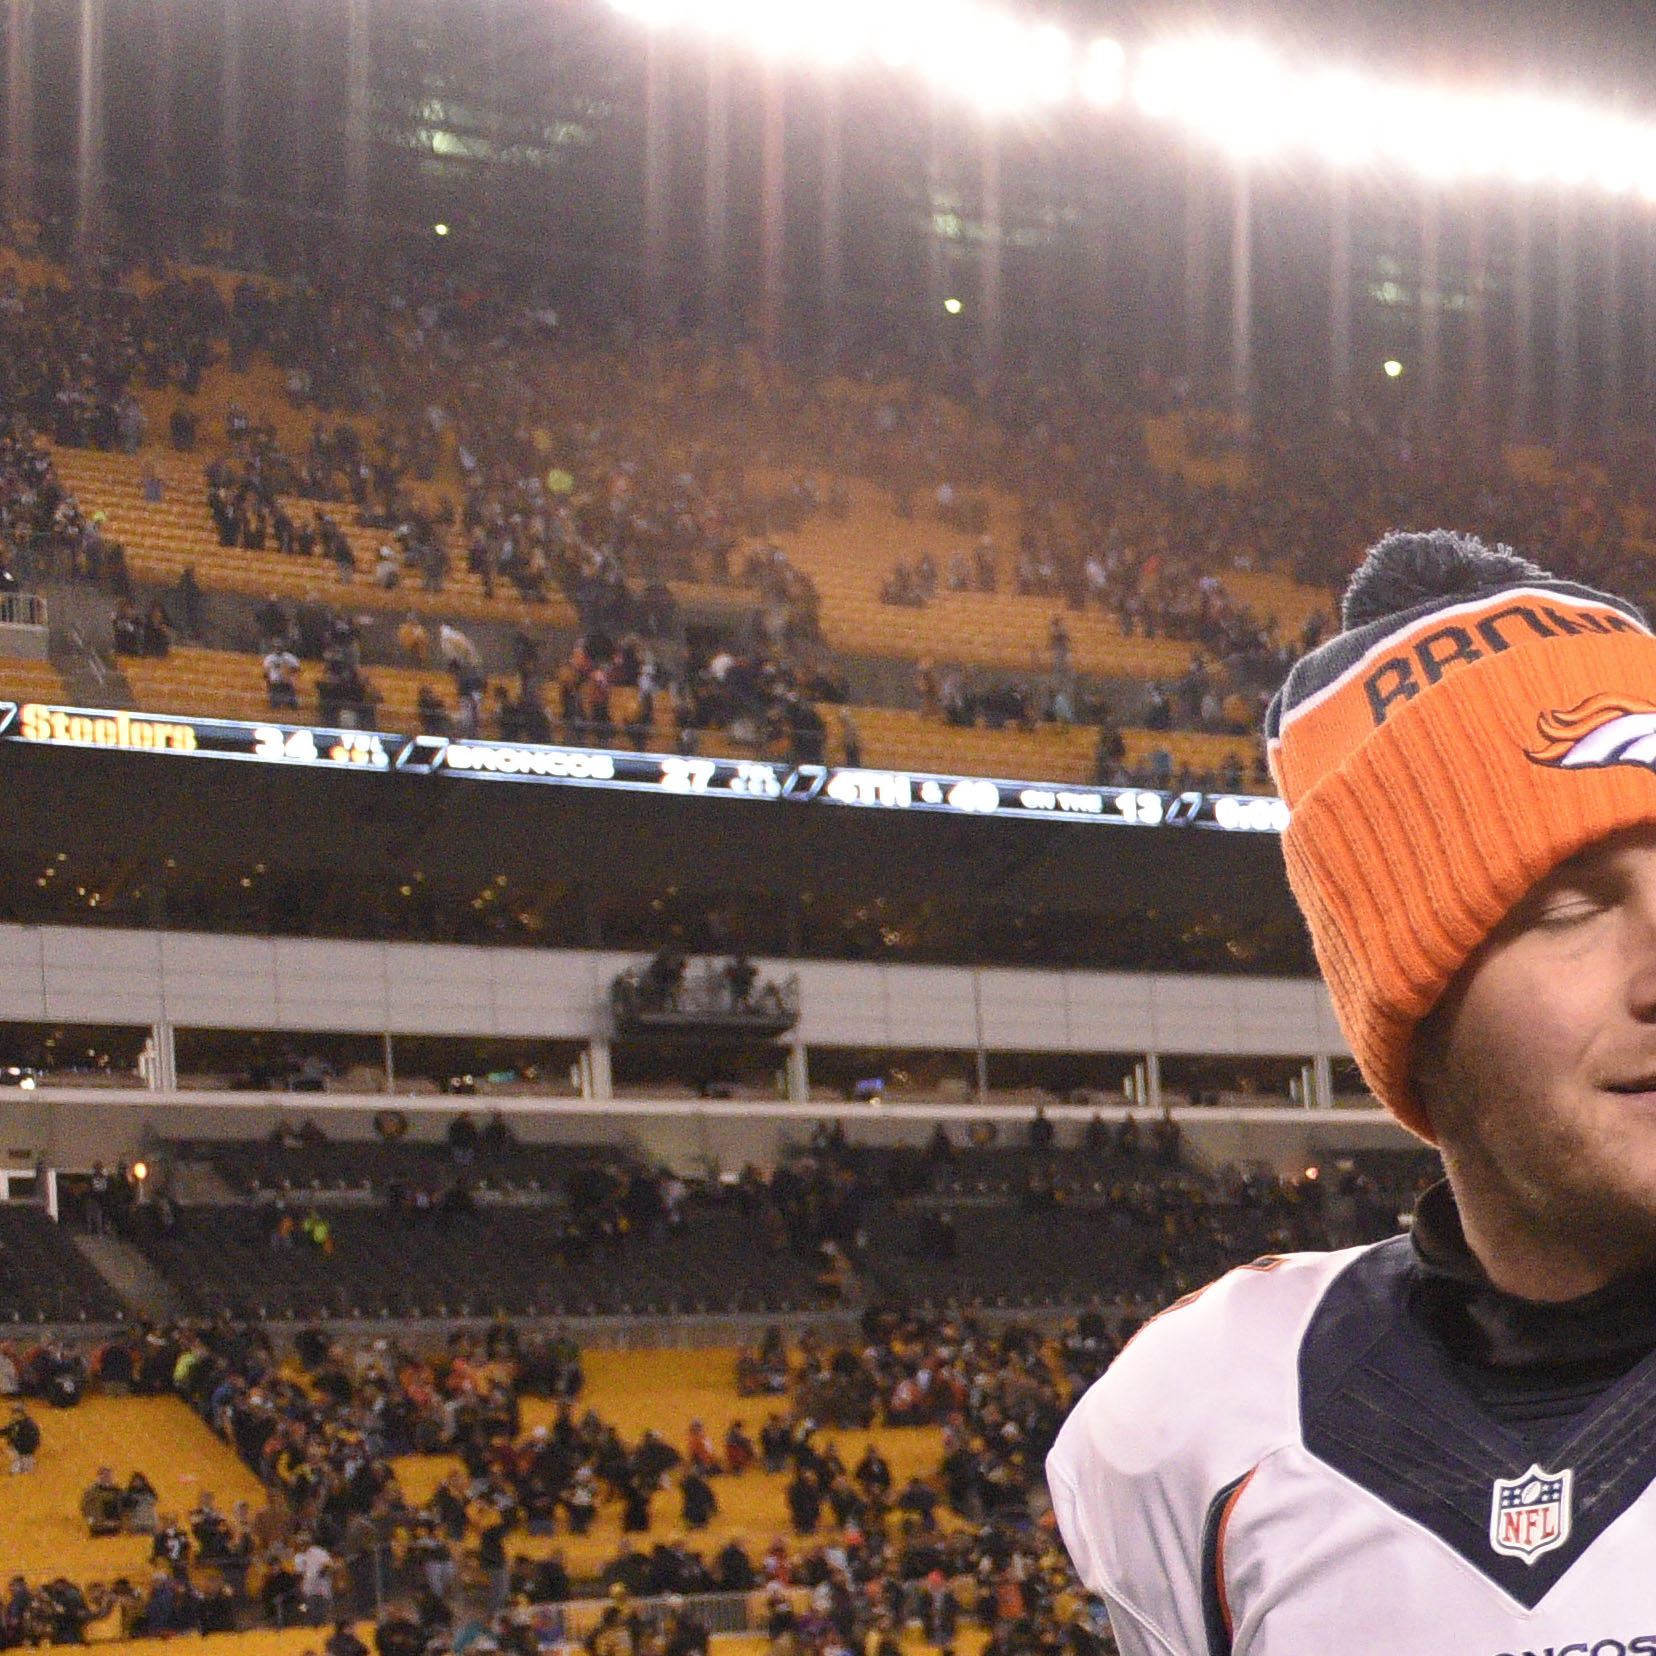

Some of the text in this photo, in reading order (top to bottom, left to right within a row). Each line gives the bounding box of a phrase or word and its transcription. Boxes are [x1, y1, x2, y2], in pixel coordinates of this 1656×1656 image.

[20, 703, 197, 750] Steelers
[254, 726, 318, 760] 34
[446, 744, 615, 779] BRONCOS
[661, 758, 715, 793] 27
[1502, 1505, 1557, 1546] NFL
